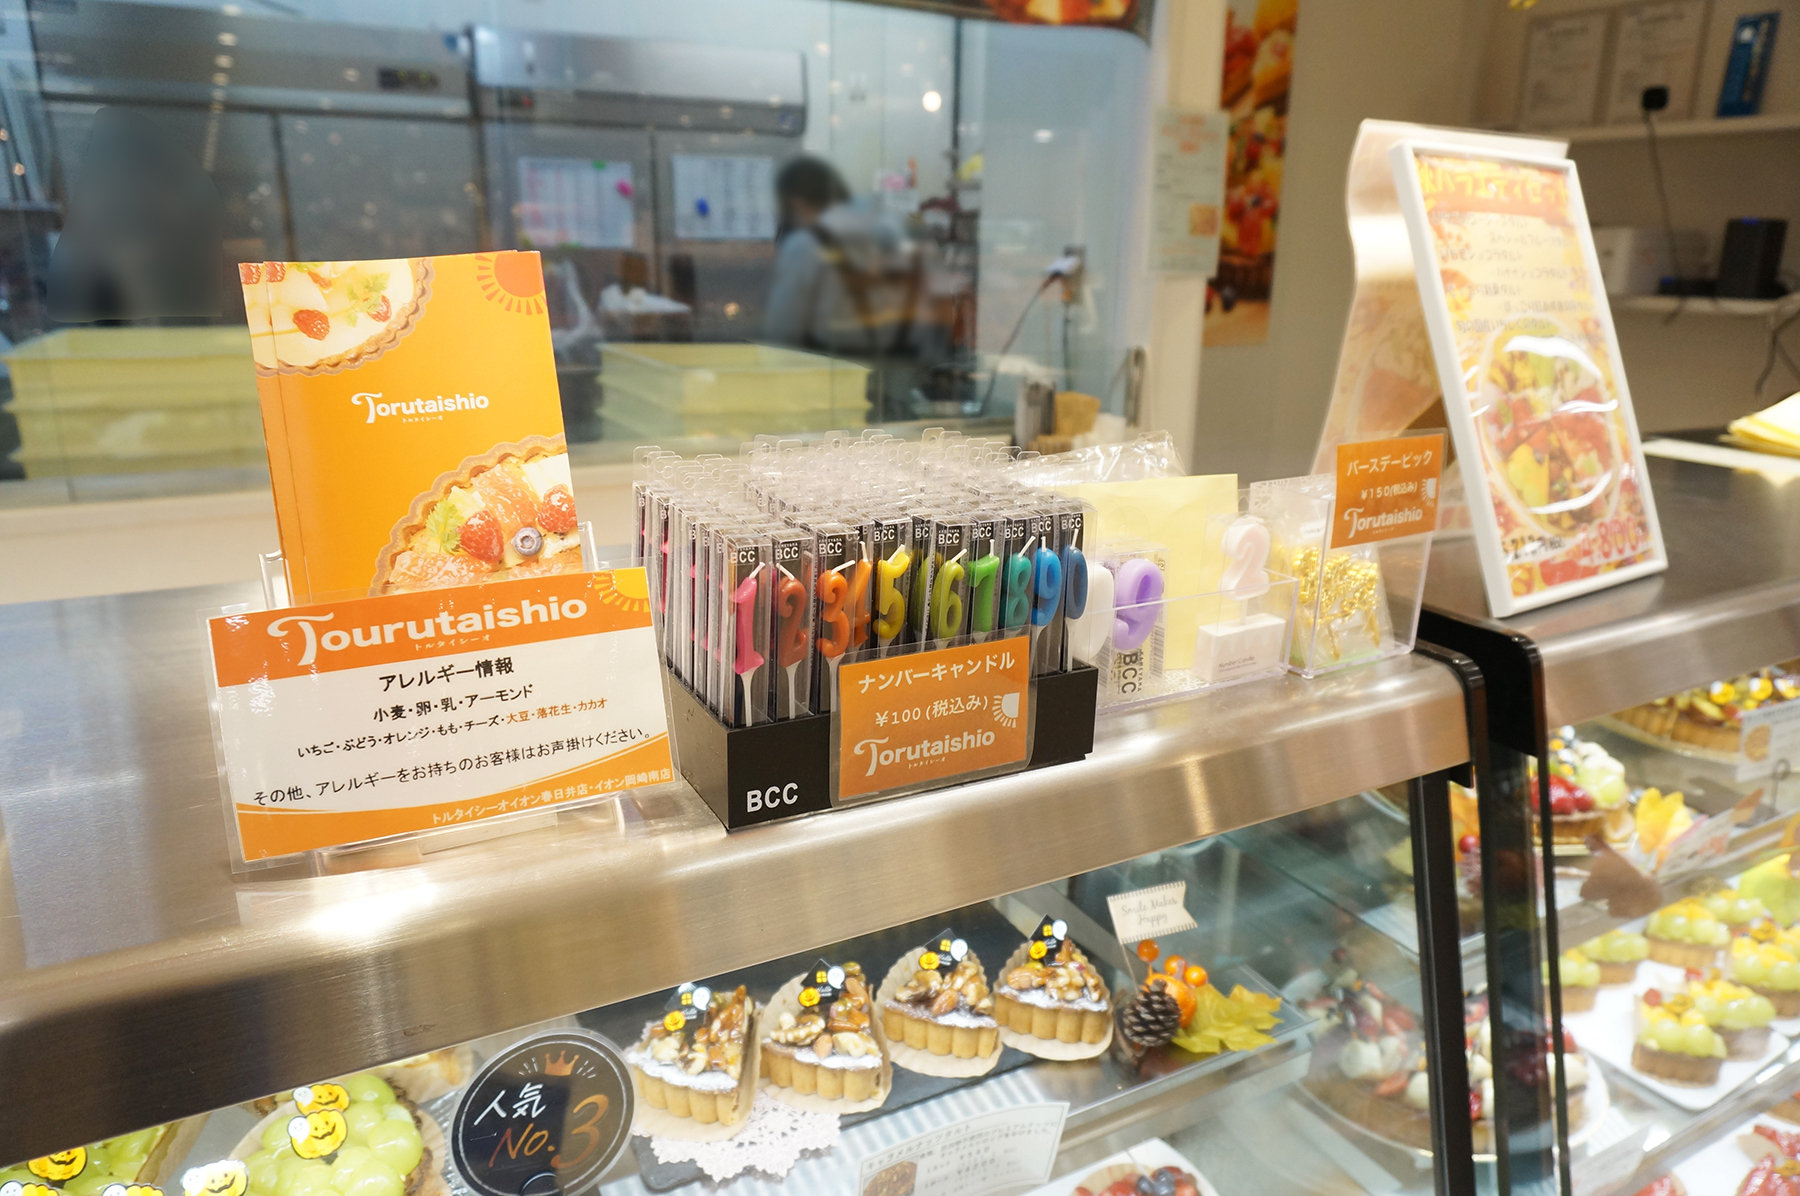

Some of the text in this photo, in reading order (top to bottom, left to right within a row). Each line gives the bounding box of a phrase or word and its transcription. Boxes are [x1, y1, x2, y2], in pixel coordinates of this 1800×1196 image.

[352, 392, 489, 423] Torutaishio
[1347, 450, 1432, 476] バースデーピック
[874, 527, 895, 541] BCC
[972, 526, 992, 539] BCC
[1005, 525, 1024, 538] BCC
[1061, 517, 1082, 530] BCC
[1344, 506, 1422, 538] Torutaishio
[775, 547, 799, 560] BCC
[819, 542, 842, 555] BCC
[938, 532, 960, 545] BCC
[266, 596, 587, 666] Tourutaishio
[415, 635, 490, 651] トルタイシーオ
[379, 657, 514, 692] アレルギー情報
[858, 651, 1015, 693] ナンバーキャンドル
[1121, 652, 1139, 694] BCC
[373, 684, 533, 722] 小麦・卵・乳・アーモンド
[253, 729, 651, 806] その他、アレルギーをお持ちのお客様はお声掛けください。
[854, 729, 995, 776] Torutaishio
[746, 782, 799, 813] BCC
[1121, 895, 1178, 916] Smile Makes
[1138, 913, 1168, 928] Happy
[473, 1082, 546, 1126] 人気
[866, 1125, 971, 1170] キャラメルナッツタルト
